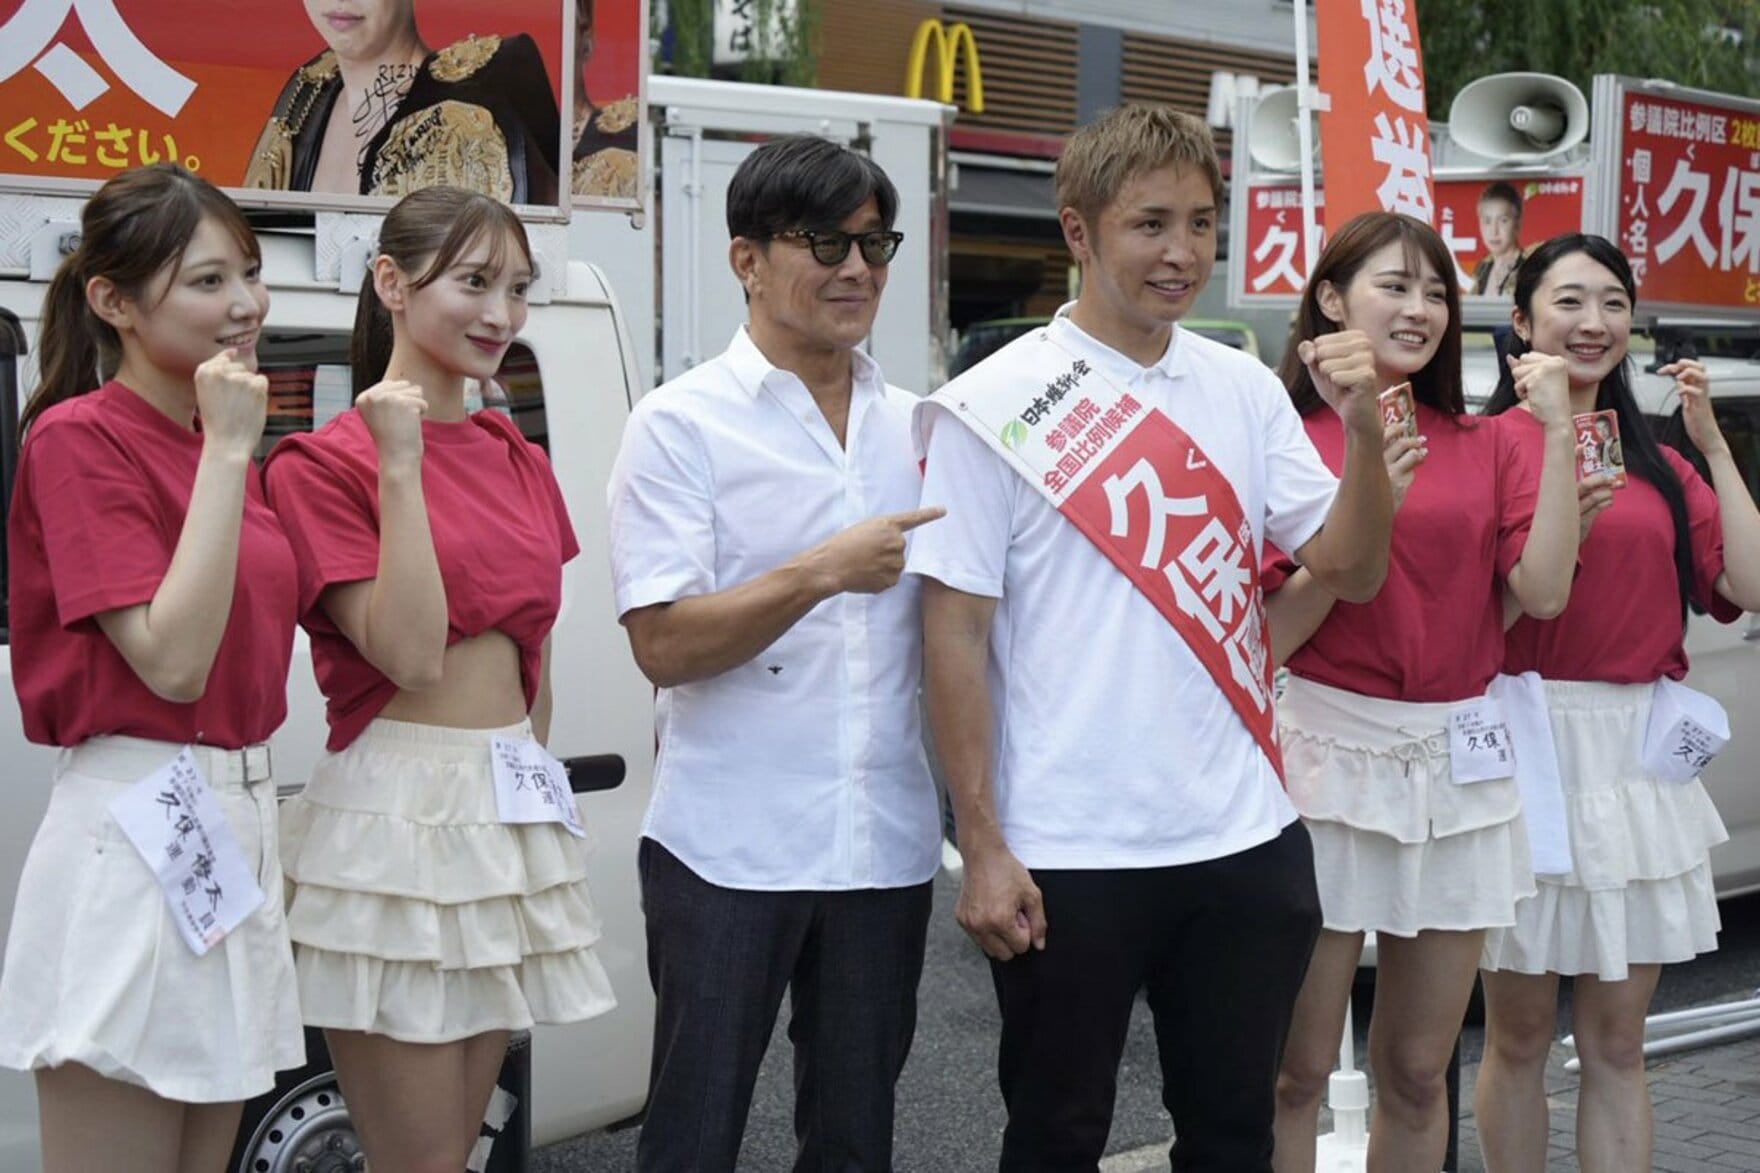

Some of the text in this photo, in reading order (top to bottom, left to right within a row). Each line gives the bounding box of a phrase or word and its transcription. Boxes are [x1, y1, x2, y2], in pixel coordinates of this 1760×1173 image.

[4, 117, 200, 172] ください。
[1730, 119, 1760, 150] 2枚
[1020, 359, 1092, 426] 日本維新の会
[1043, 392, 1142, 495] 全国比例候補
[1045, 397, 1101, 453] 参議院
